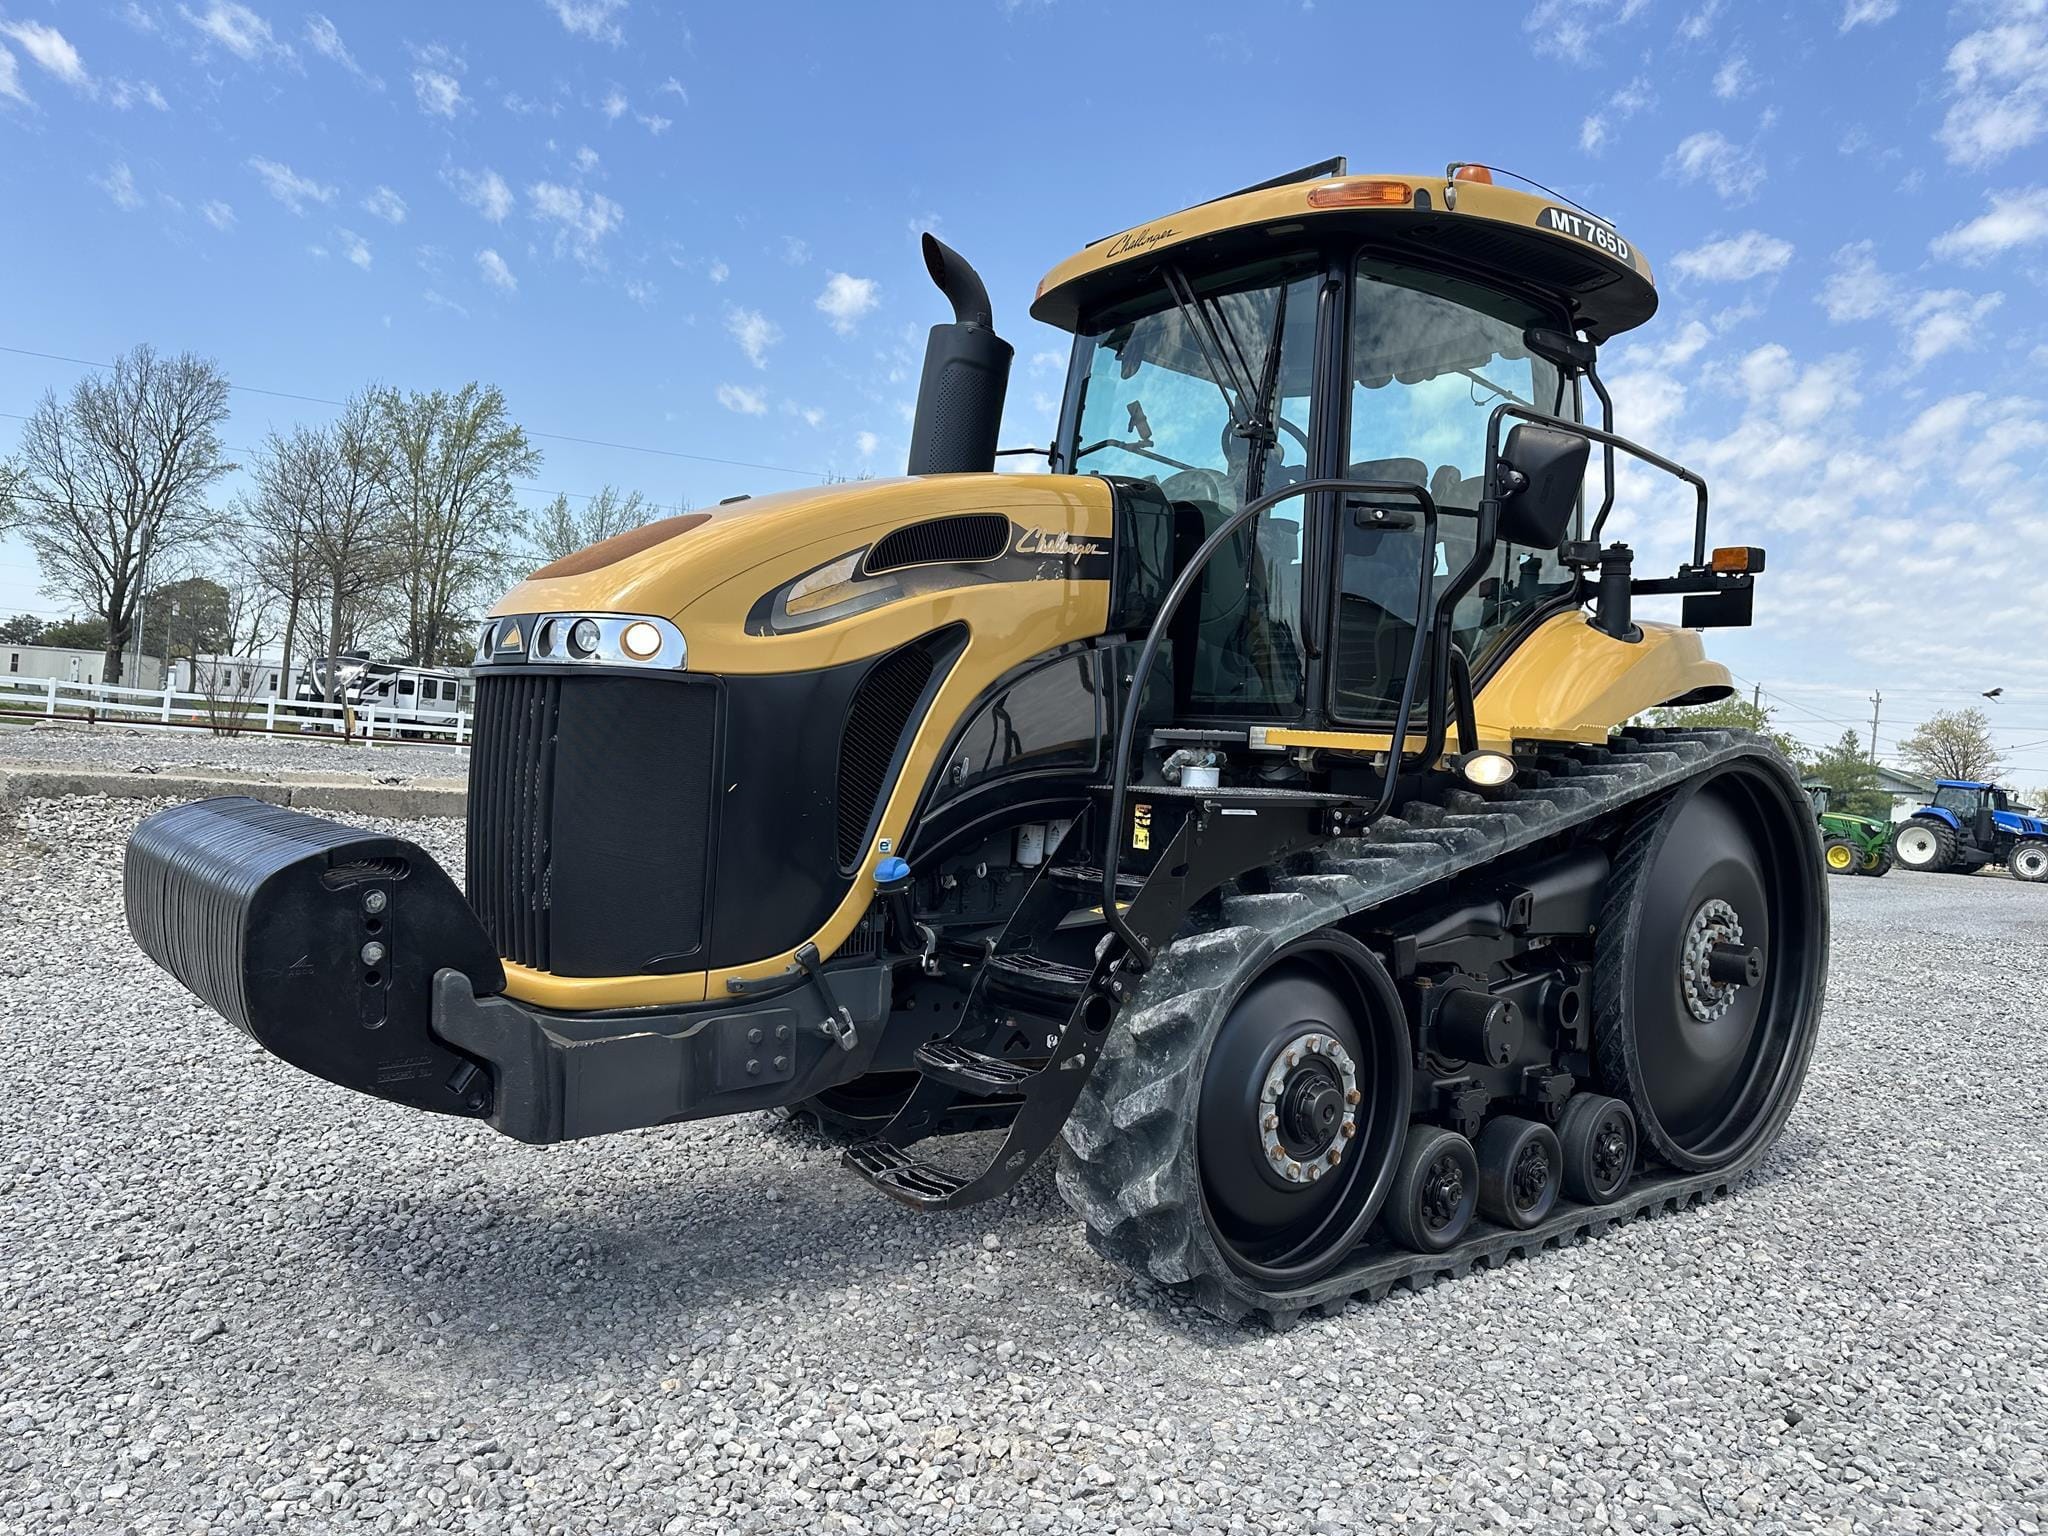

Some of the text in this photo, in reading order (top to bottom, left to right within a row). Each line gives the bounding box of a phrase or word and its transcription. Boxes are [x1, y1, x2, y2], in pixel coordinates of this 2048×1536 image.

[1106, 228, 1183, 258] Challenger
[1550, 208, 1628, 259] MT765D
[1015, 526, 1109, 565] Challenger
